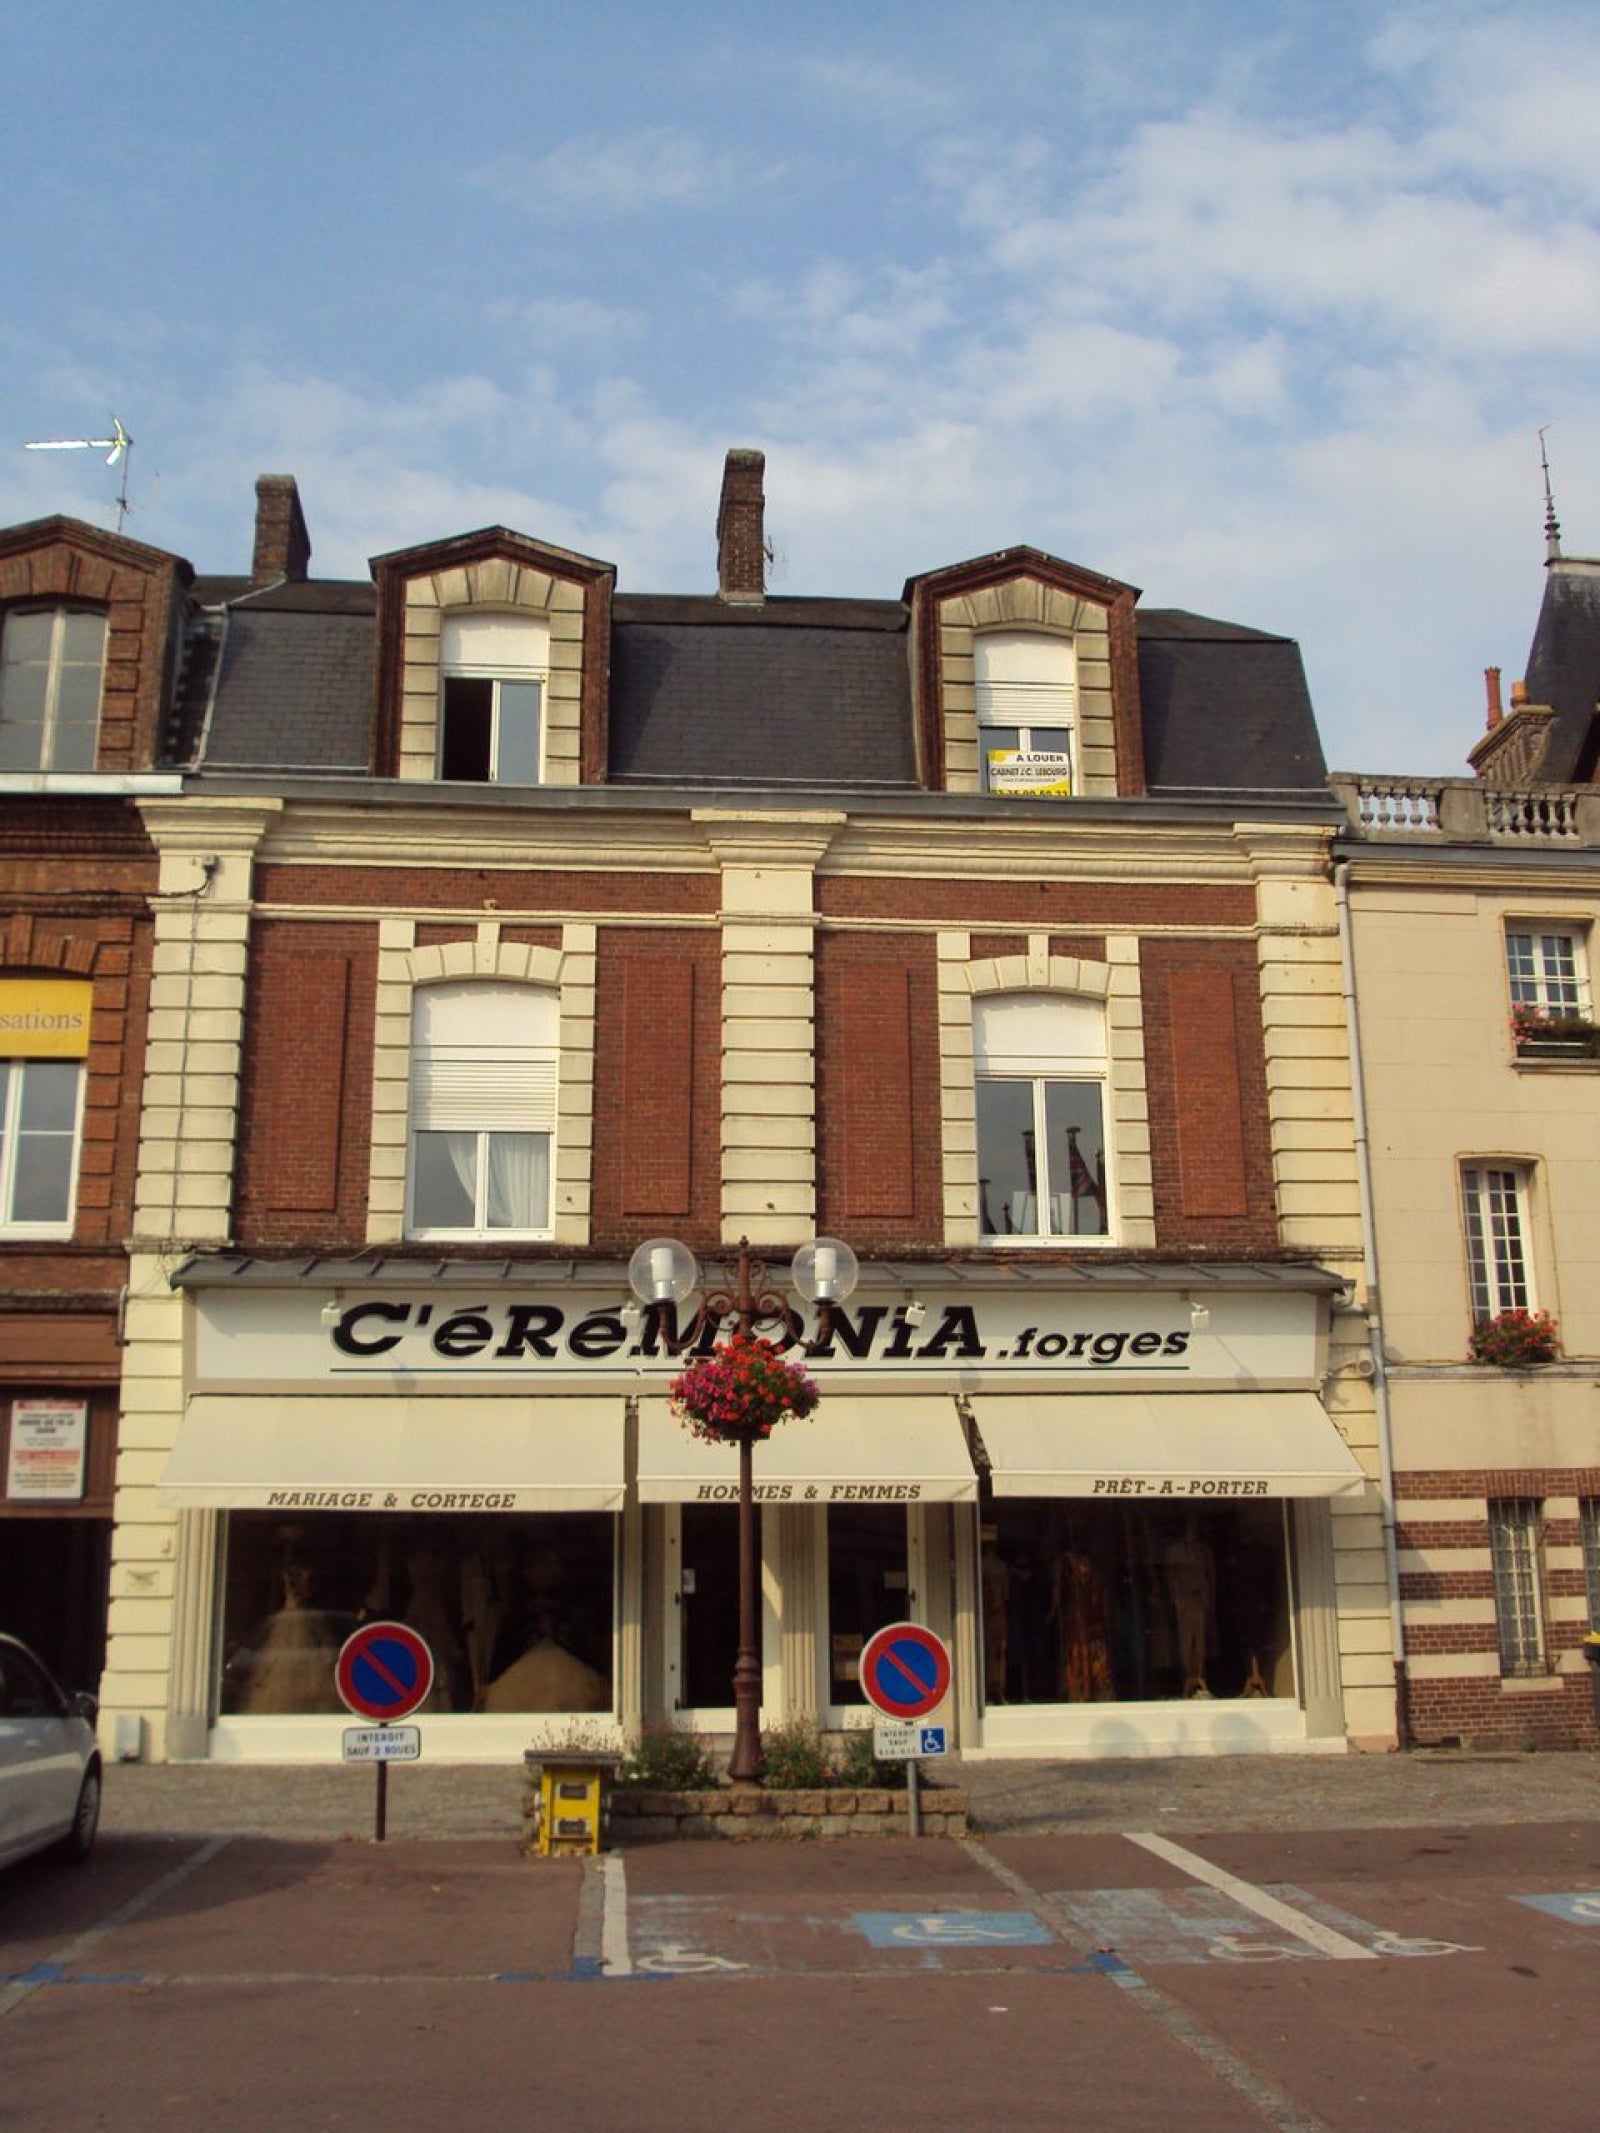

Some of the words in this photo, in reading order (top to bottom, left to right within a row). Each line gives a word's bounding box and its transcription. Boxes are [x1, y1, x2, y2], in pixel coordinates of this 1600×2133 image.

[1016, 754, 1024, 762] A
[1026, 754, 1064, 762] LOUER
[804, 1484, 819, 1499] &
[829, 1484, 921, 1499] FEMMES
[266, 1492, 373, 1507] MARIAGE
[383, 1492, 399, 1508] &
[411, 1493, 516, 1508] CORTEGE
[358, 1732, 404, 1742] INTERDIT
[347, 1746, 369, 1756] SAUF
